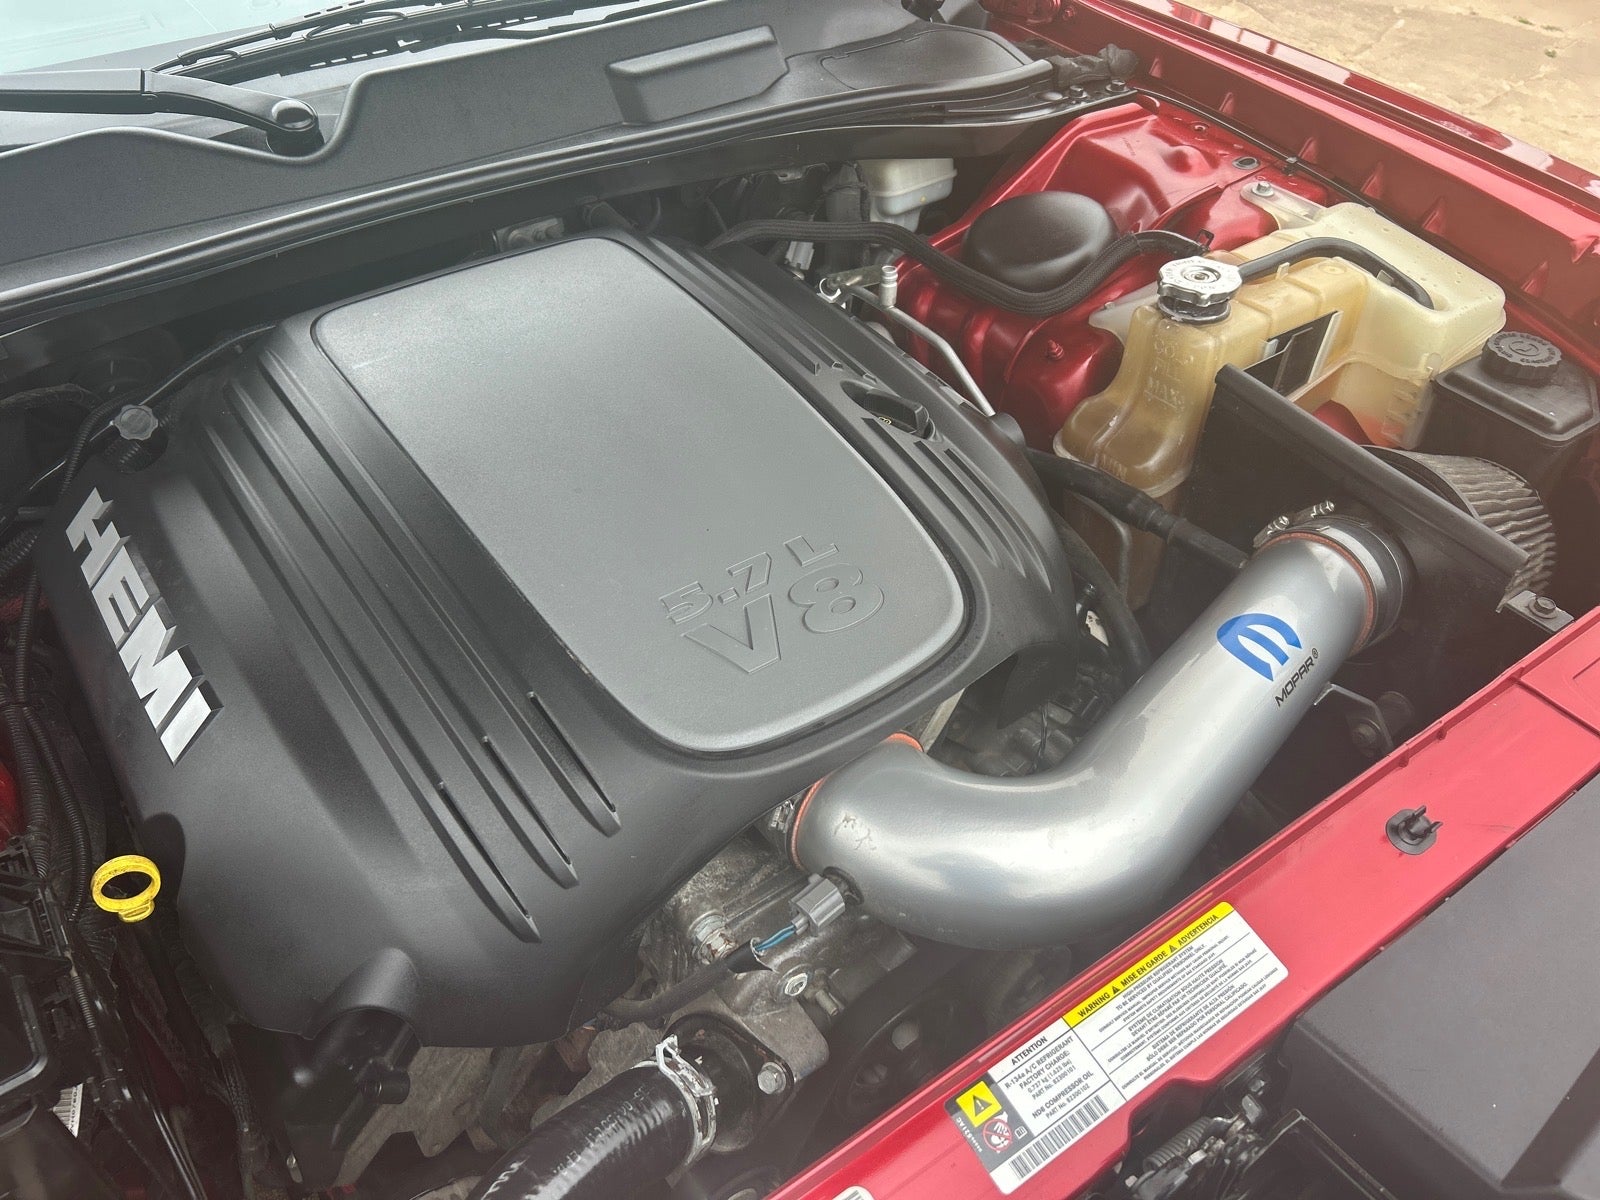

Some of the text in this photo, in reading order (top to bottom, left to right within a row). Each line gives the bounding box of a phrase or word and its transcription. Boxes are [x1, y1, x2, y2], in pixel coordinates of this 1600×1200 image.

[65, 487, 215, 766] HEMI
[680, 563, 885, 674] V8
[1176, 912, 1219, 946] ADVERTENCIA
[1119, 949, 1168, 987] MISE EN GARDE
[1077, 991, 1111, 1018] WARNING
[1010, 1035, 1048, 1065] ATTENTION
[1023, 1062, 1038, 1075] A/C
[1035, 1035, 1074, 1066] REFRIGERANT
[1018, 1048, 1070, 1089] FACTORY CHARGE:
[1040, 1075, 1049, 1084] kg
[1031, 1087, 1045, 1100] PART
[1043, 1076, 1084, 1109] COMPRESSOR
[1081, 1069, 1094, 1080] OIL
[1044, 1106, 1059, 1119] PART
